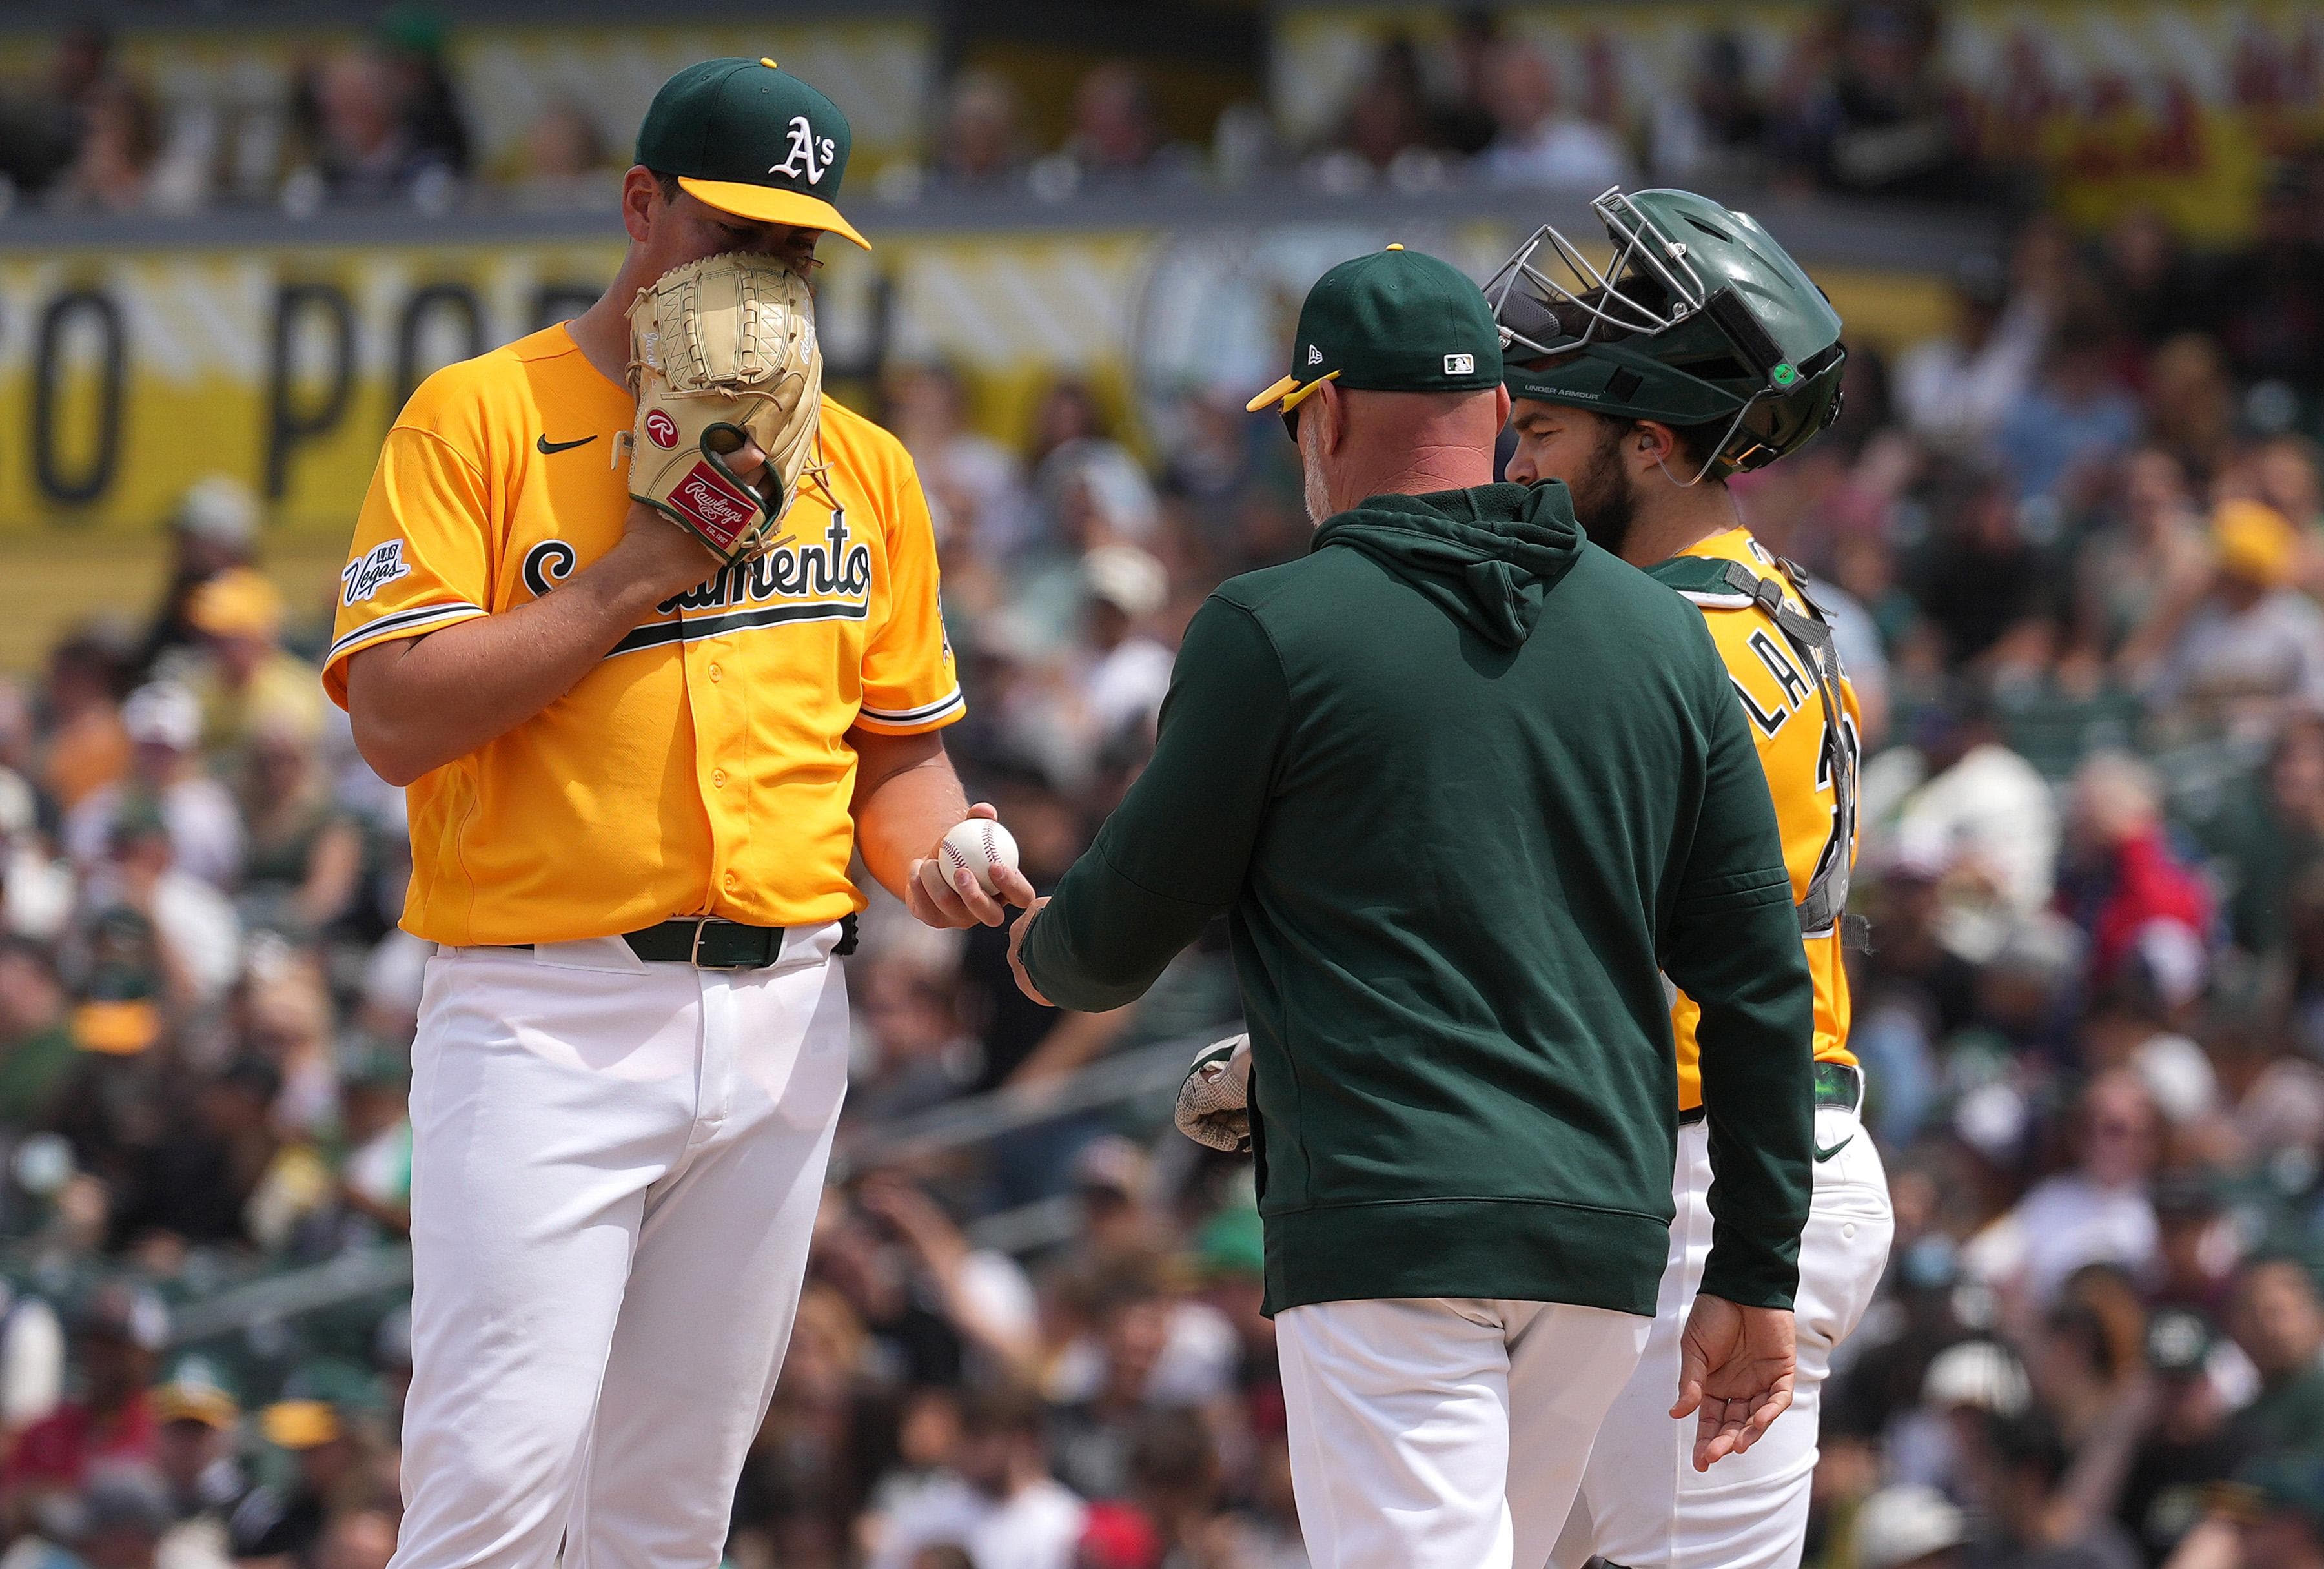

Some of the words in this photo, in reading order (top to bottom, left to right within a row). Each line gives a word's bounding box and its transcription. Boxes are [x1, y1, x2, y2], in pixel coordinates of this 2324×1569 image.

[768, 116, 835, 185] A's
[1525, 384, 1556, 395] UNDER
[1558, 389, 1599, 400] ARMOUR
[684, 482, 742, 524] Rawlings
[376, 544, 399, 564] LAS
[344, 553, 405, 602] Vegas
